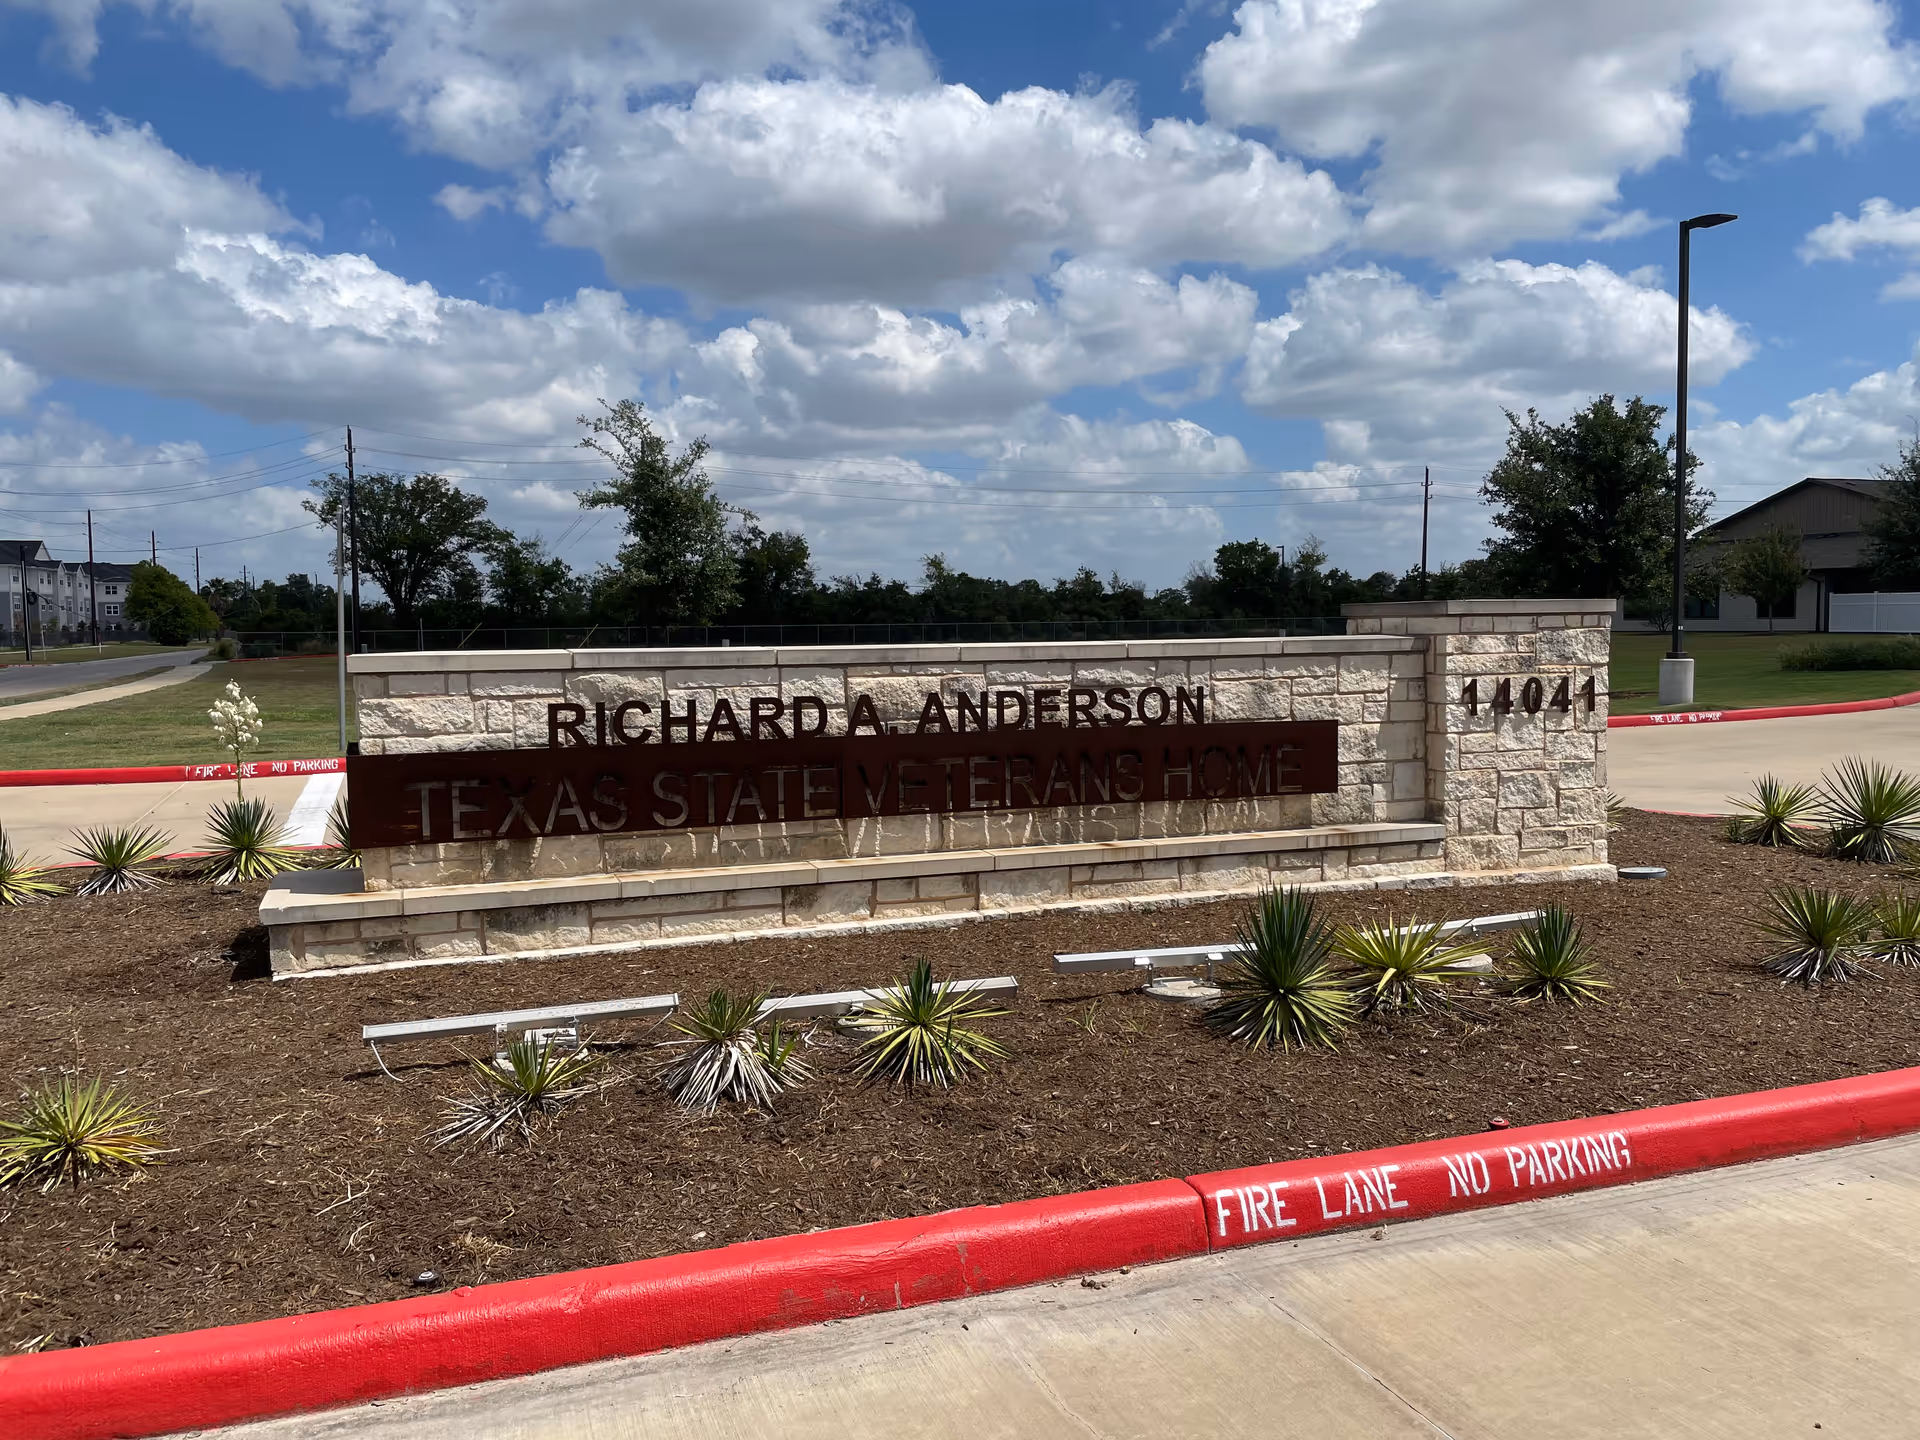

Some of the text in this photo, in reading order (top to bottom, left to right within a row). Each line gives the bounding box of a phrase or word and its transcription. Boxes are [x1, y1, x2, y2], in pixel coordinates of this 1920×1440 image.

[548, 696, 827, 750] RICHARD
[917, 686, 1205, 734] ANDERSON
[1461, 675, 1596, 716] 14041
[228, 763, 258, 778] LNE
[272, 762, 287, 773] NO
[293, 759, 339, 772] PARKING
[403, 744, 1305, 841] TEXAS STATE VETERANS HOME
[1216, 1131, 1631, 1237] FIRE LANE NO PARKING
